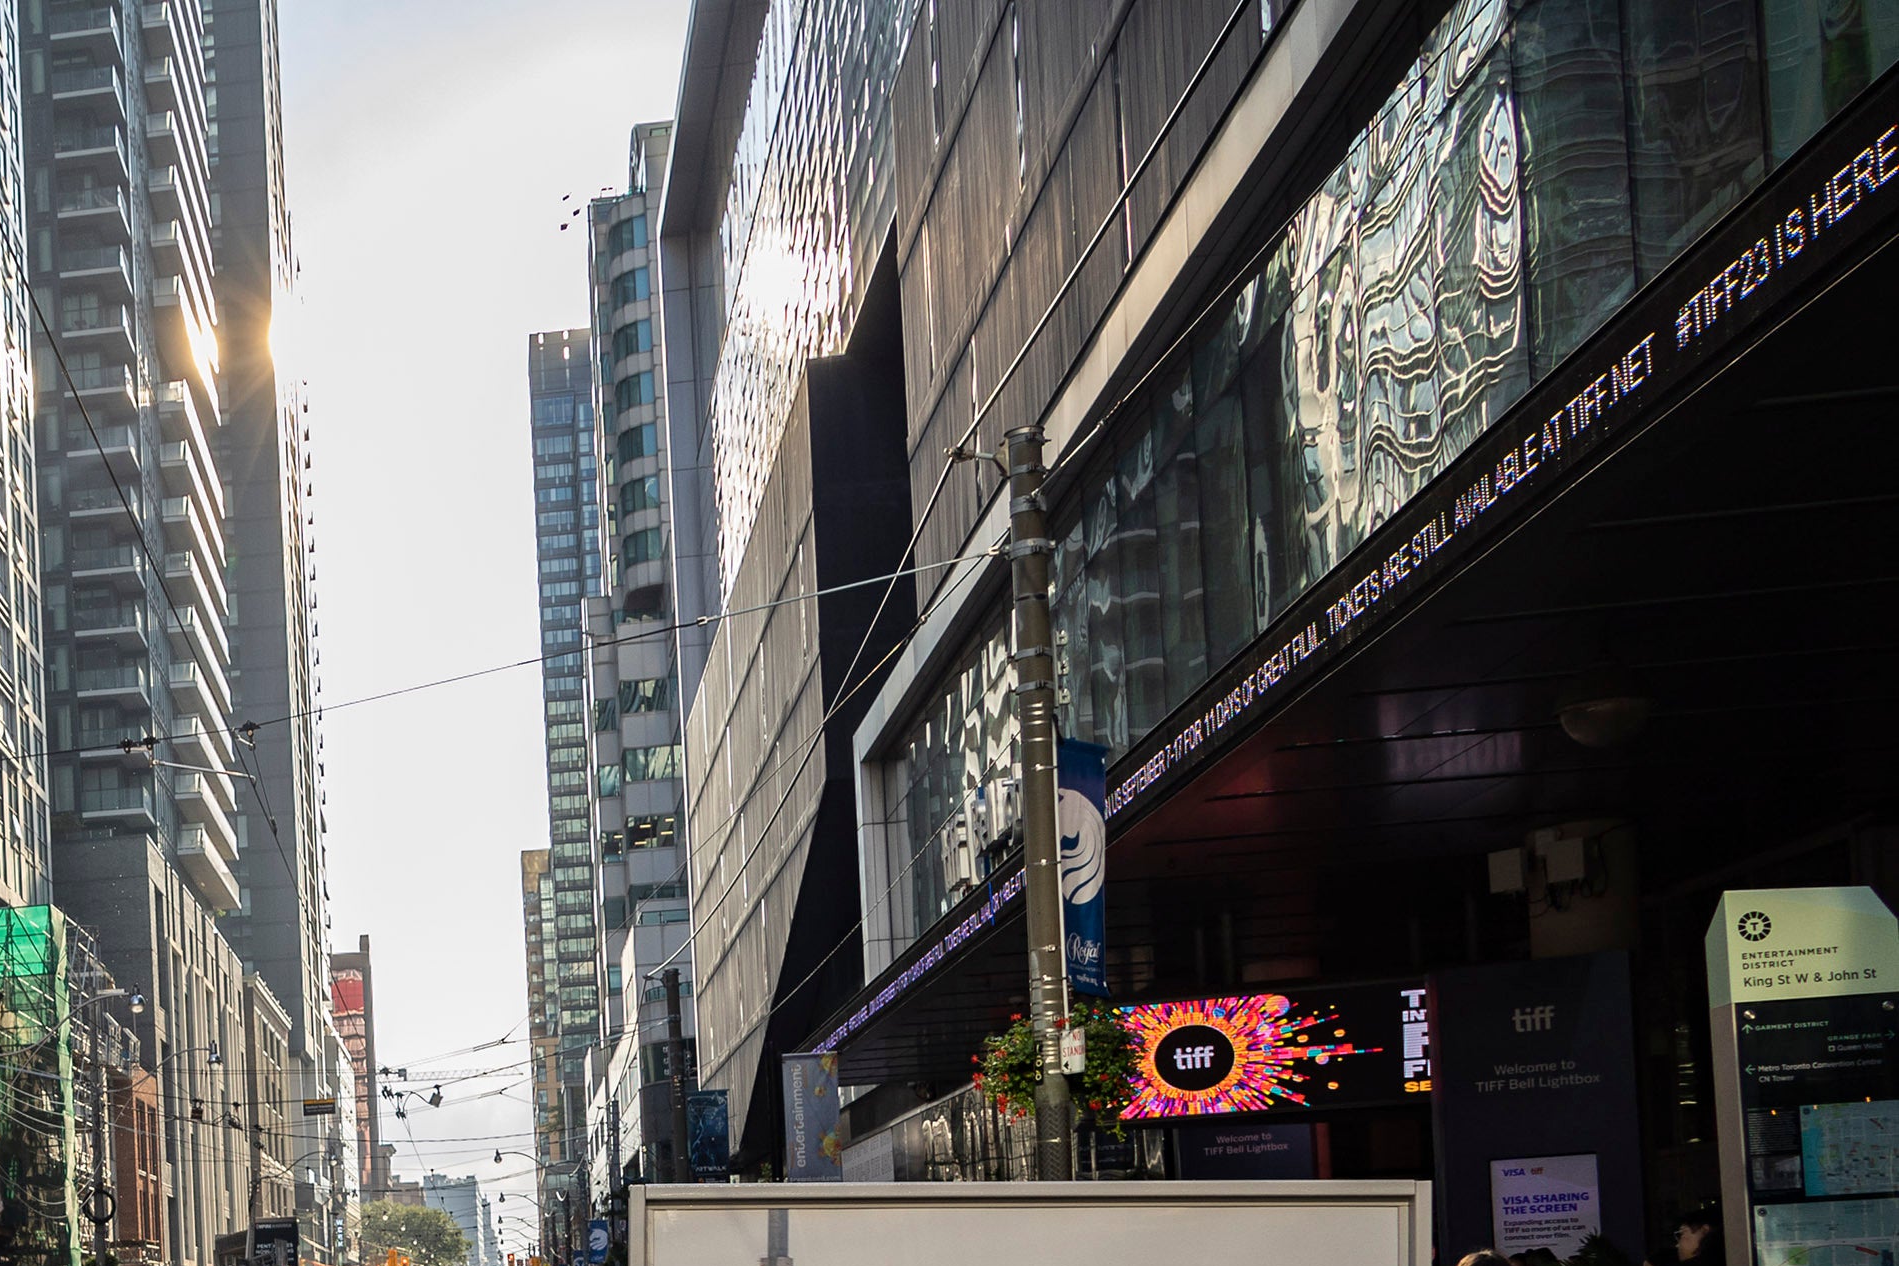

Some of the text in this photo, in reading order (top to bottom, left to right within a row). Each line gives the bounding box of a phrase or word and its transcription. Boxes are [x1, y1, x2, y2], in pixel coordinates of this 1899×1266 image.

[1674, 123, 1899, 352] #TIFF23 IS HERE
[1325, 332, 1656, 637] TICKETS ARE STILL AVAILABLE AT TIFF.NET
[1120, 753, 1167, 808] SEPTEMBER
[1182, 720, 1204, 753] FOR
[1215, 687, 1242, 730] DAYS
[1241, 673, 1256, 708] OF
[1255, 643, 1292, 695] GREAT
[1066, 932, 1101, 965] Royal
[1741, 946, 1839, 961] ENTERTAINMENT
[1742, 959, 1795, 971] DISTRICT
[1743, 968, 1877, 988] King St W & John St
[1512, 1005, 1555, 1033] tiff
[1755, 1020, 1830, 1032] GARMENT DISTRICT
[1827, 1033, 1860, 1042] GRANGE
[1173, 1045, 1215, 1070] tiff
[1494, 1059, 1576, 1076] Welcome to
[1757, 1065, 1780, 1073] Metro
[1782, 1062, 1811, 1071] Toronto
[1812, 1060, 1855, 1070] Convention
[1475, 1072, 1601, 1093] TIFF Bell Lightbox
[1758, 1074, 1795, 1084] CN Tower
[792, 1063, 807, 1168] entertainment
[1215, 1131, 1272, 1145] Welcome to
[1204, 1142, 1289, 1157] TIFF Bell Lightbox
[1501, 1167, 1526, 1177] VISA
[1502, 1191, 1590, 1206] VISA SHARING
[1502, 1202, 1579, 1216] THE SCREEN
[1503, 1219, 1544, 1228] Expanding
